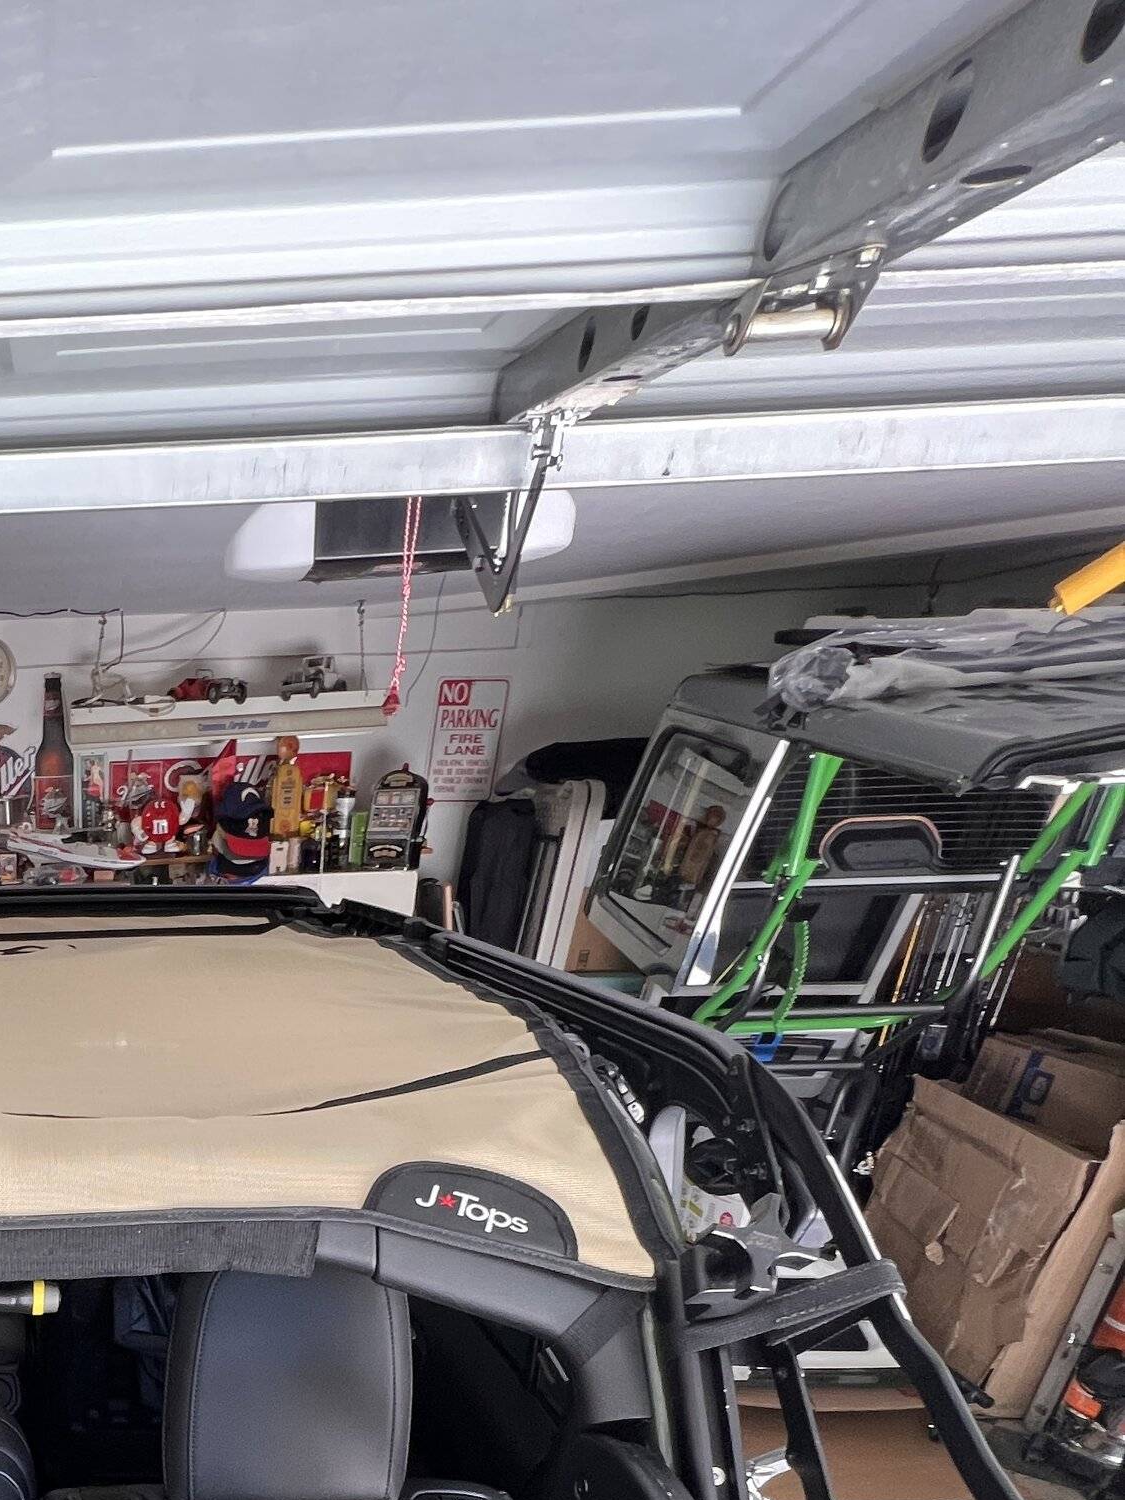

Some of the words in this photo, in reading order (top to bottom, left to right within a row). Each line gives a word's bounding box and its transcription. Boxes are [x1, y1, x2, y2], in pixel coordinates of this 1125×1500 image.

[440, 683, 469, 703] NO
[440, 709, 500, 728] PARKING
[449, 733, 484, 744] FIRE
[443, 745, 485, 756] LANE
